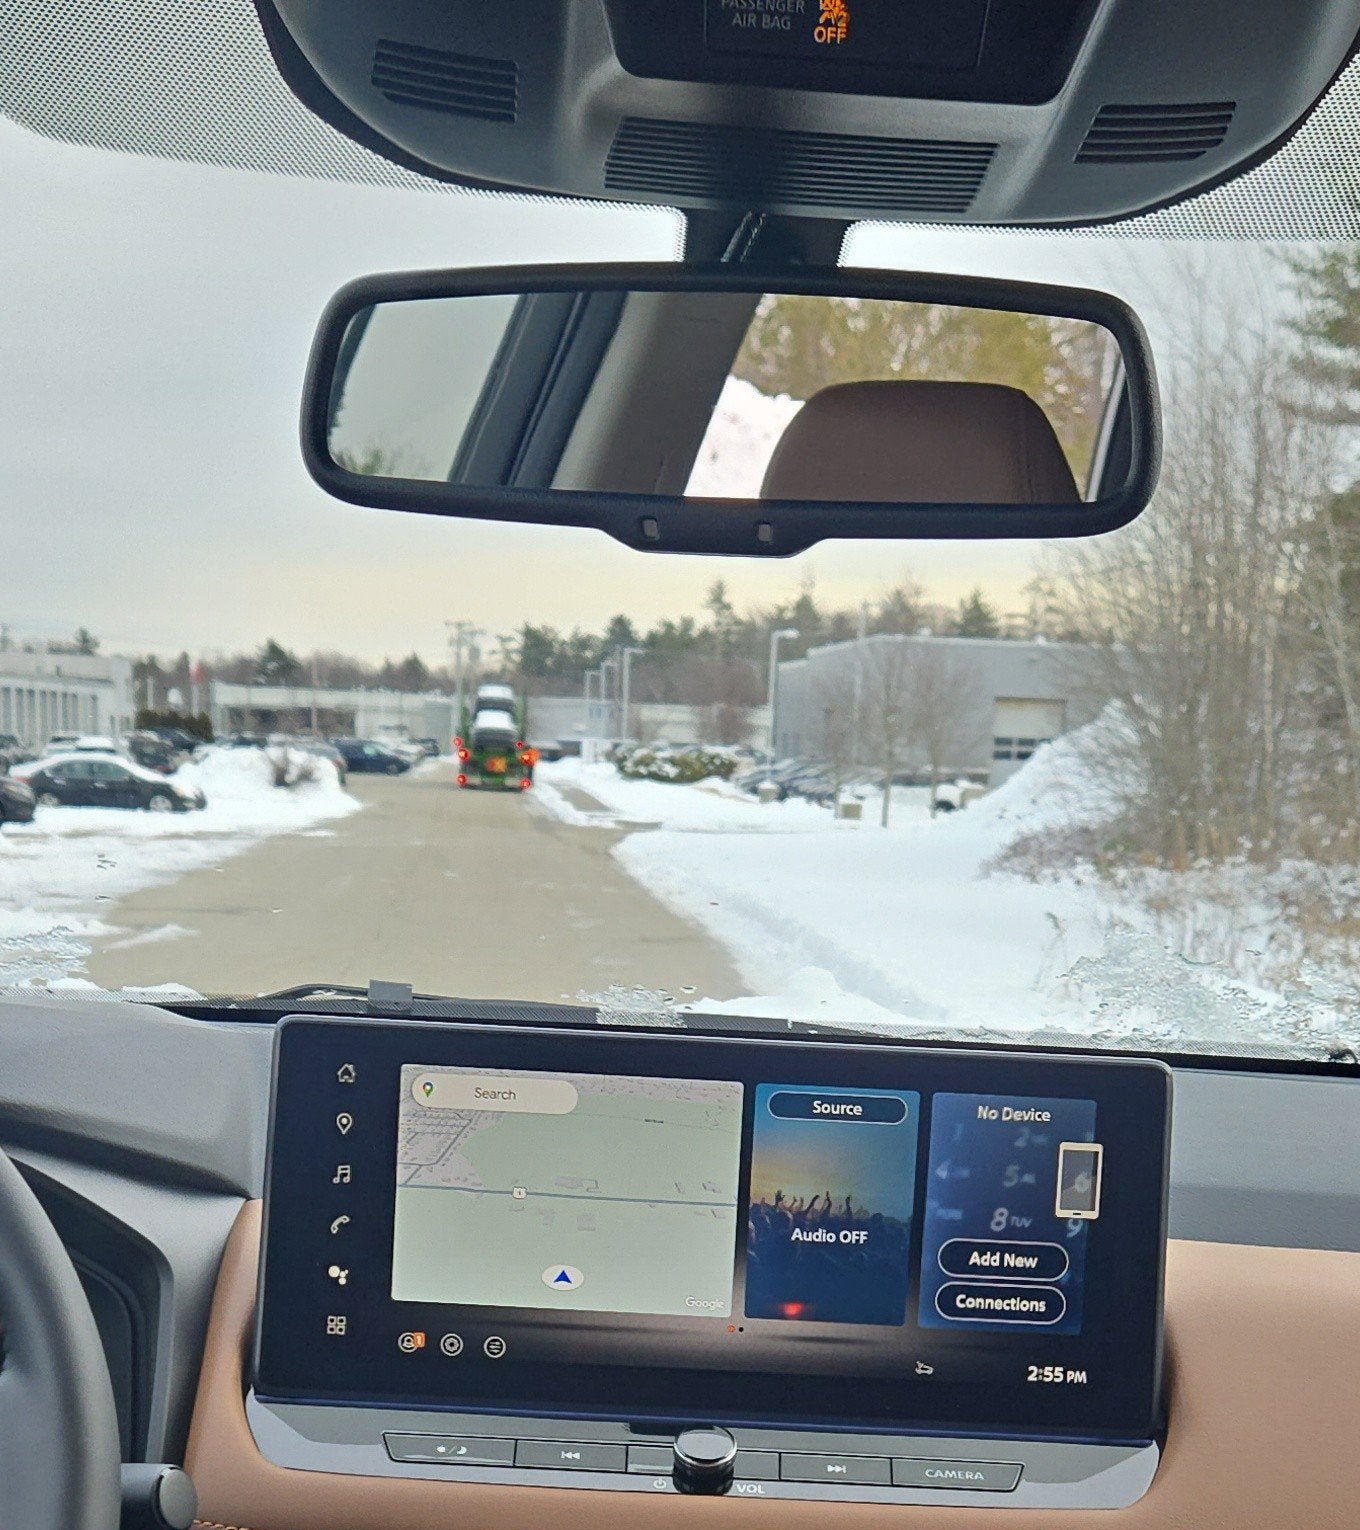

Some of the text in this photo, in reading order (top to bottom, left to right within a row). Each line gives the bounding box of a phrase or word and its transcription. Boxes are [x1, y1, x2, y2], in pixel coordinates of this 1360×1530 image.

[732, 13, 791, 30] AIR BAG
[814, 26, 847, 44] OFF
[474, 1087, 516, 1102] Search
[812, 1101, 863, 1116] Source
[977, 1105, 1051, 1122] No Device
[791, 1228, 868, 1245] Audio OFF
[969, 1251, 1038, 1269] Add New
[686, 1296, 725, 1310] Google
[956, 1294, 1046, 1312] Connections
[1027, 1366, 1087, 1383] 2:55 PM
[925, 1469, 984, 1481] CAMERA
[736, 1484, 765, 1495] VOL
